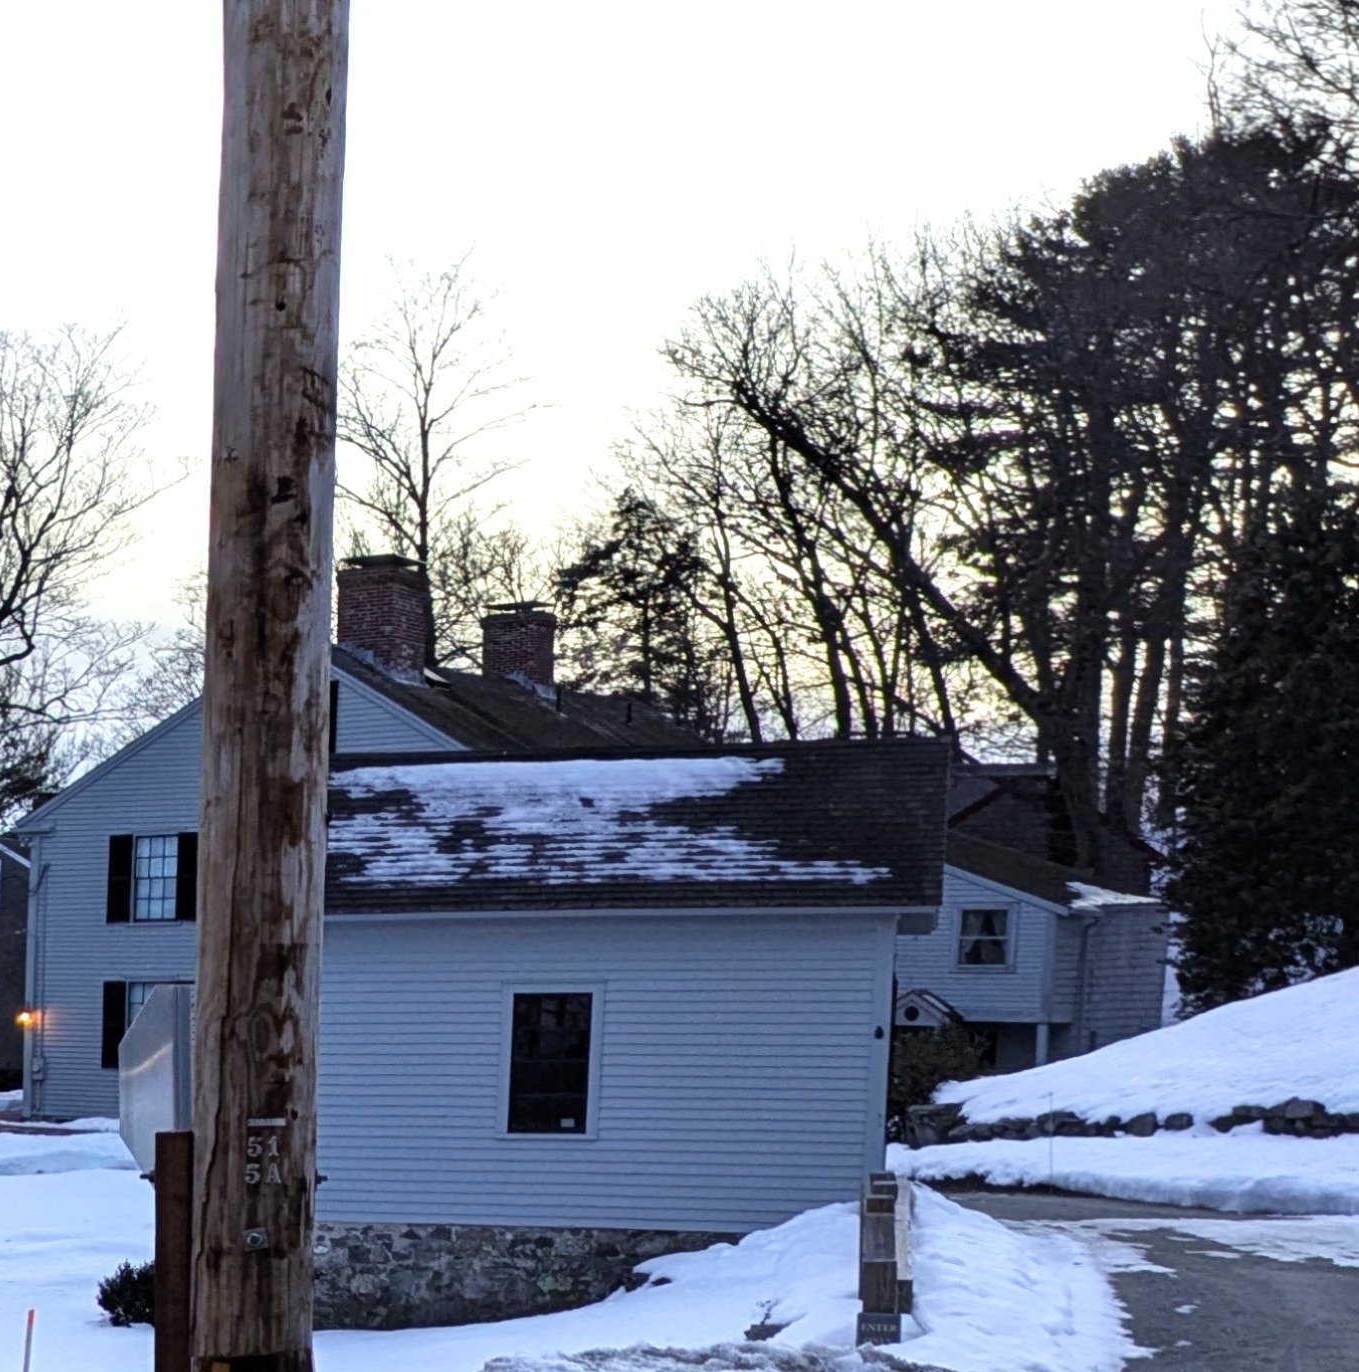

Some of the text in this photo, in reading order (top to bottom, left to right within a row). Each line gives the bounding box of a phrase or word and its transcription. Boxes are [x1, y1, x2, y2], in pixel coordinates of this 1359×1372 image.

[247, 1135, 280, 1157] 51
[245, 1163, 282, 1184] 5A
[861, 1323, 897, 1332] ENTER
